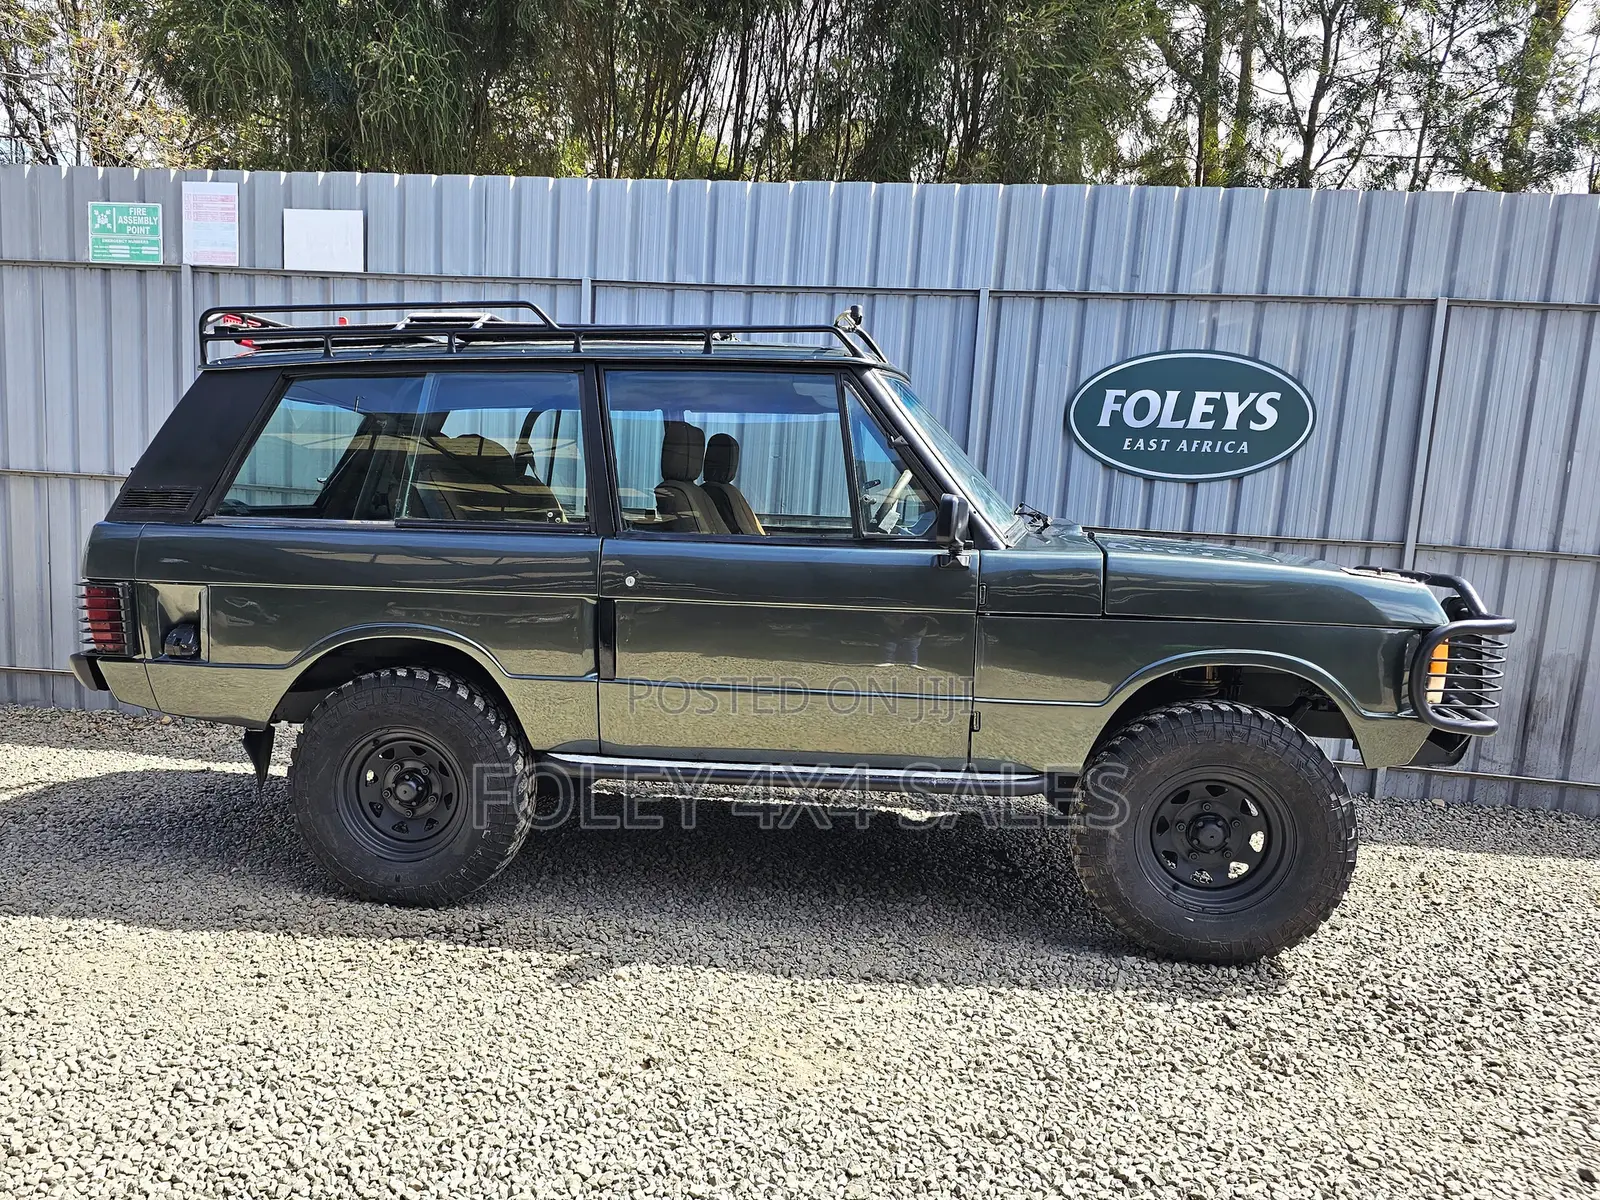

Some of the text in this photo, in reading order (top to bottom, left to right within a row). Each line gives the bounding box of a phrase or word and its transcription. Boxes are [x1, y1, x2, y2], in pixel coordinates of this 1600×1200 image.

[129, 207, 147, 216] FIRE
[118, 216, 158, 225] ASSEMBLY
[126, 226, 150, 235] POINT
[1097, 389, 1281, 432] FOLEYS
[1122, 438, 1249, 454] EAST AFRICA
